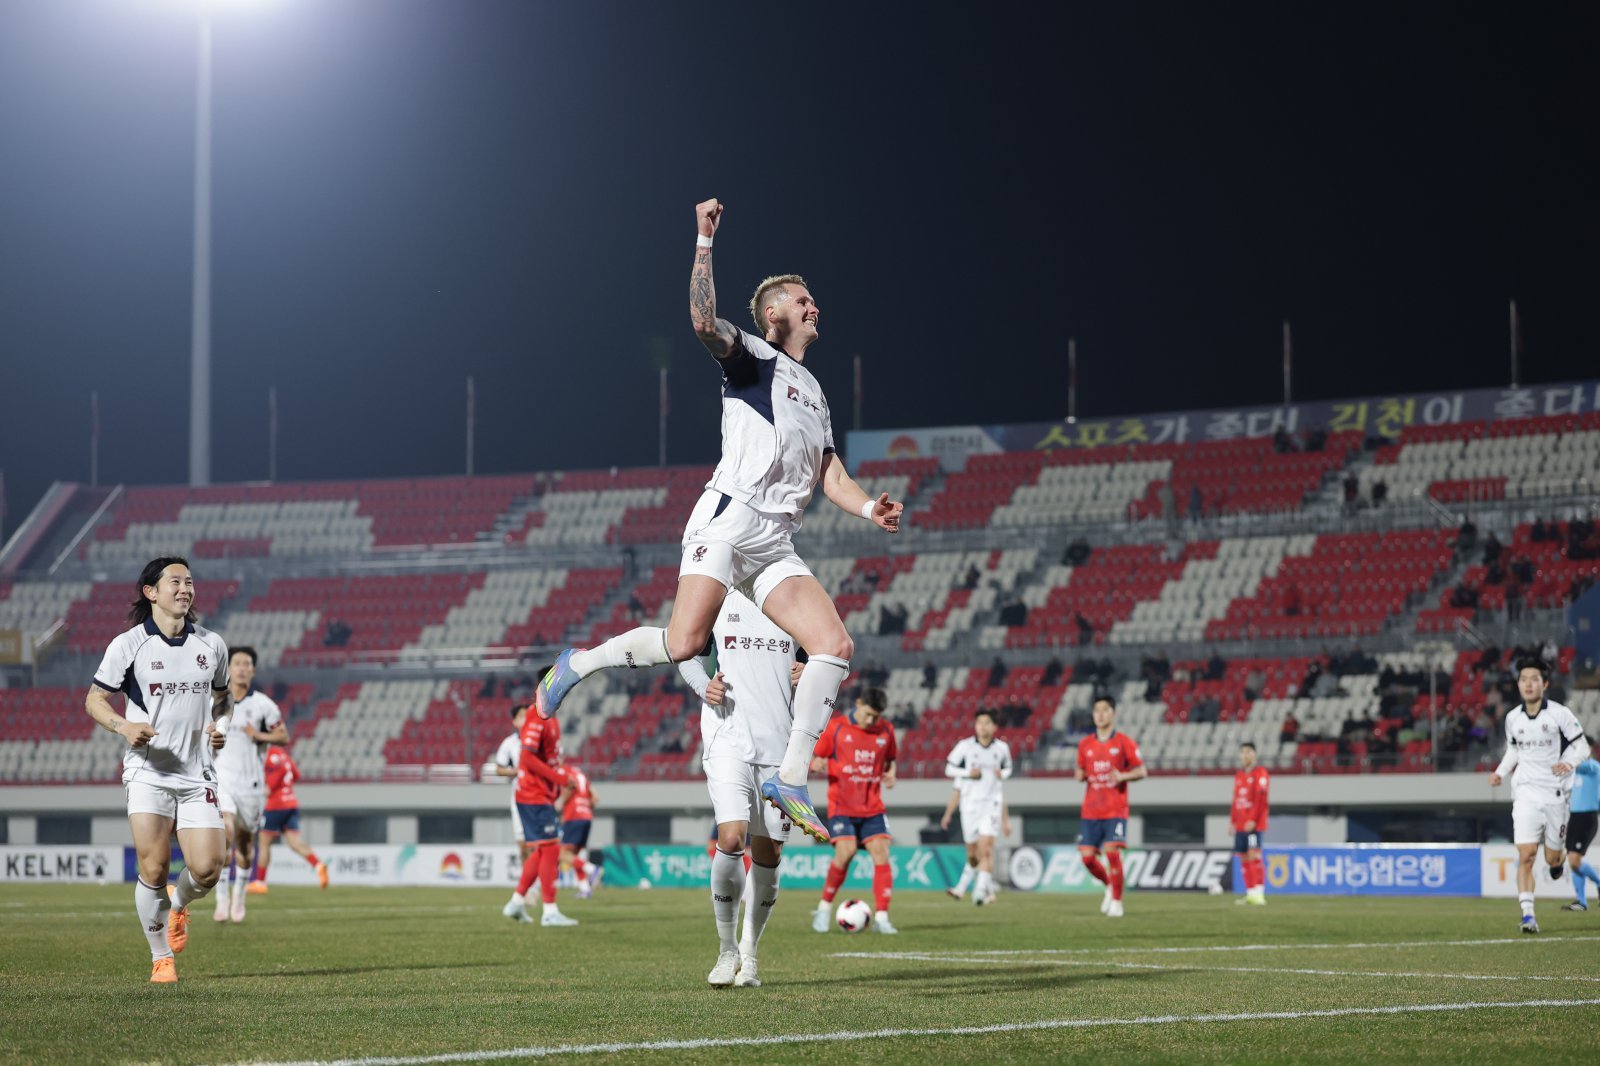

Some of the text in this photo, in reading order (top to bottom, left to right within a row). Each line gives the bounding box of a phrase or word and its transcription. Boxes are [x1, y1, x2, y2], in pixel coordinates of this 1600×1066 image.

[739, 636, 790, 654] 광주은행
[165, 682, 210, 695] 광주은행
[6, 854, 93, 877] KELME
